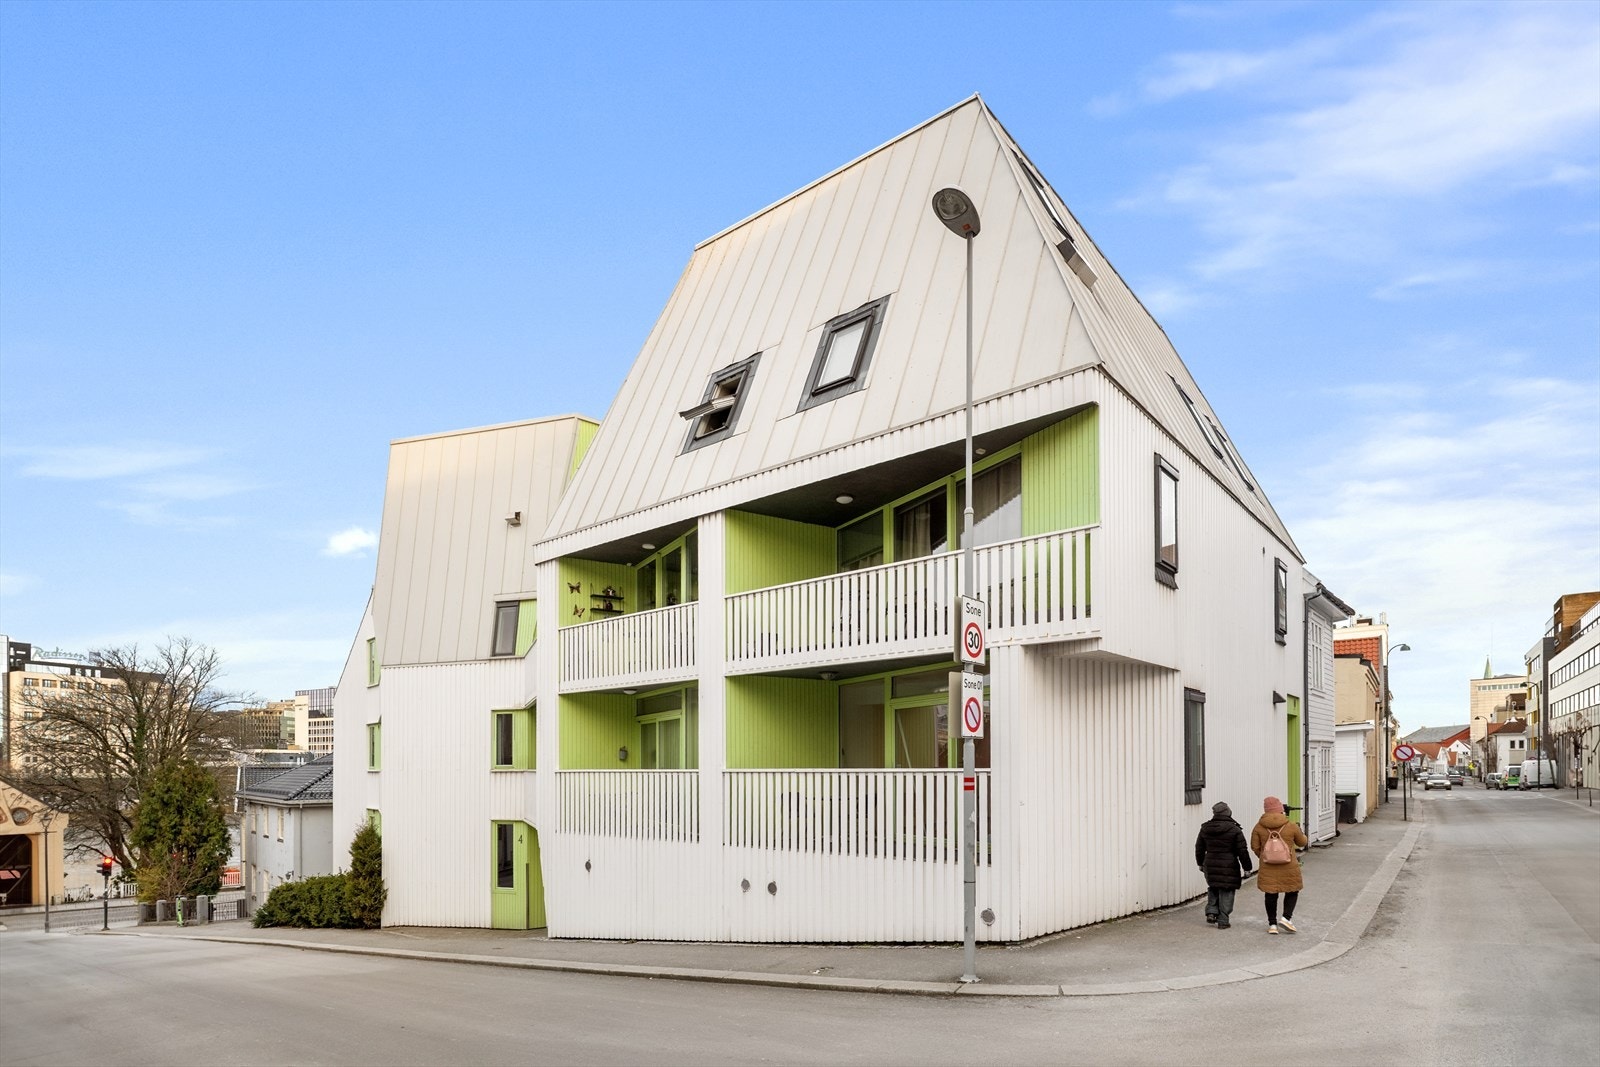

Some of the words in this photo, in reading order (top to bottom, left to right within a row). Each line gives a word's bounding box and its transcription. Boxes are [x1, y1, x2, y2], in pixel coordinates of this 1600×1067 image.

[966, 602, 982, 617] Sone
[968, 630, 980, 650] 30
[32, 646, 87, 661] Radisson
[964, 678, 976, 690] Sone
[518, 834, 523, 844] 4
